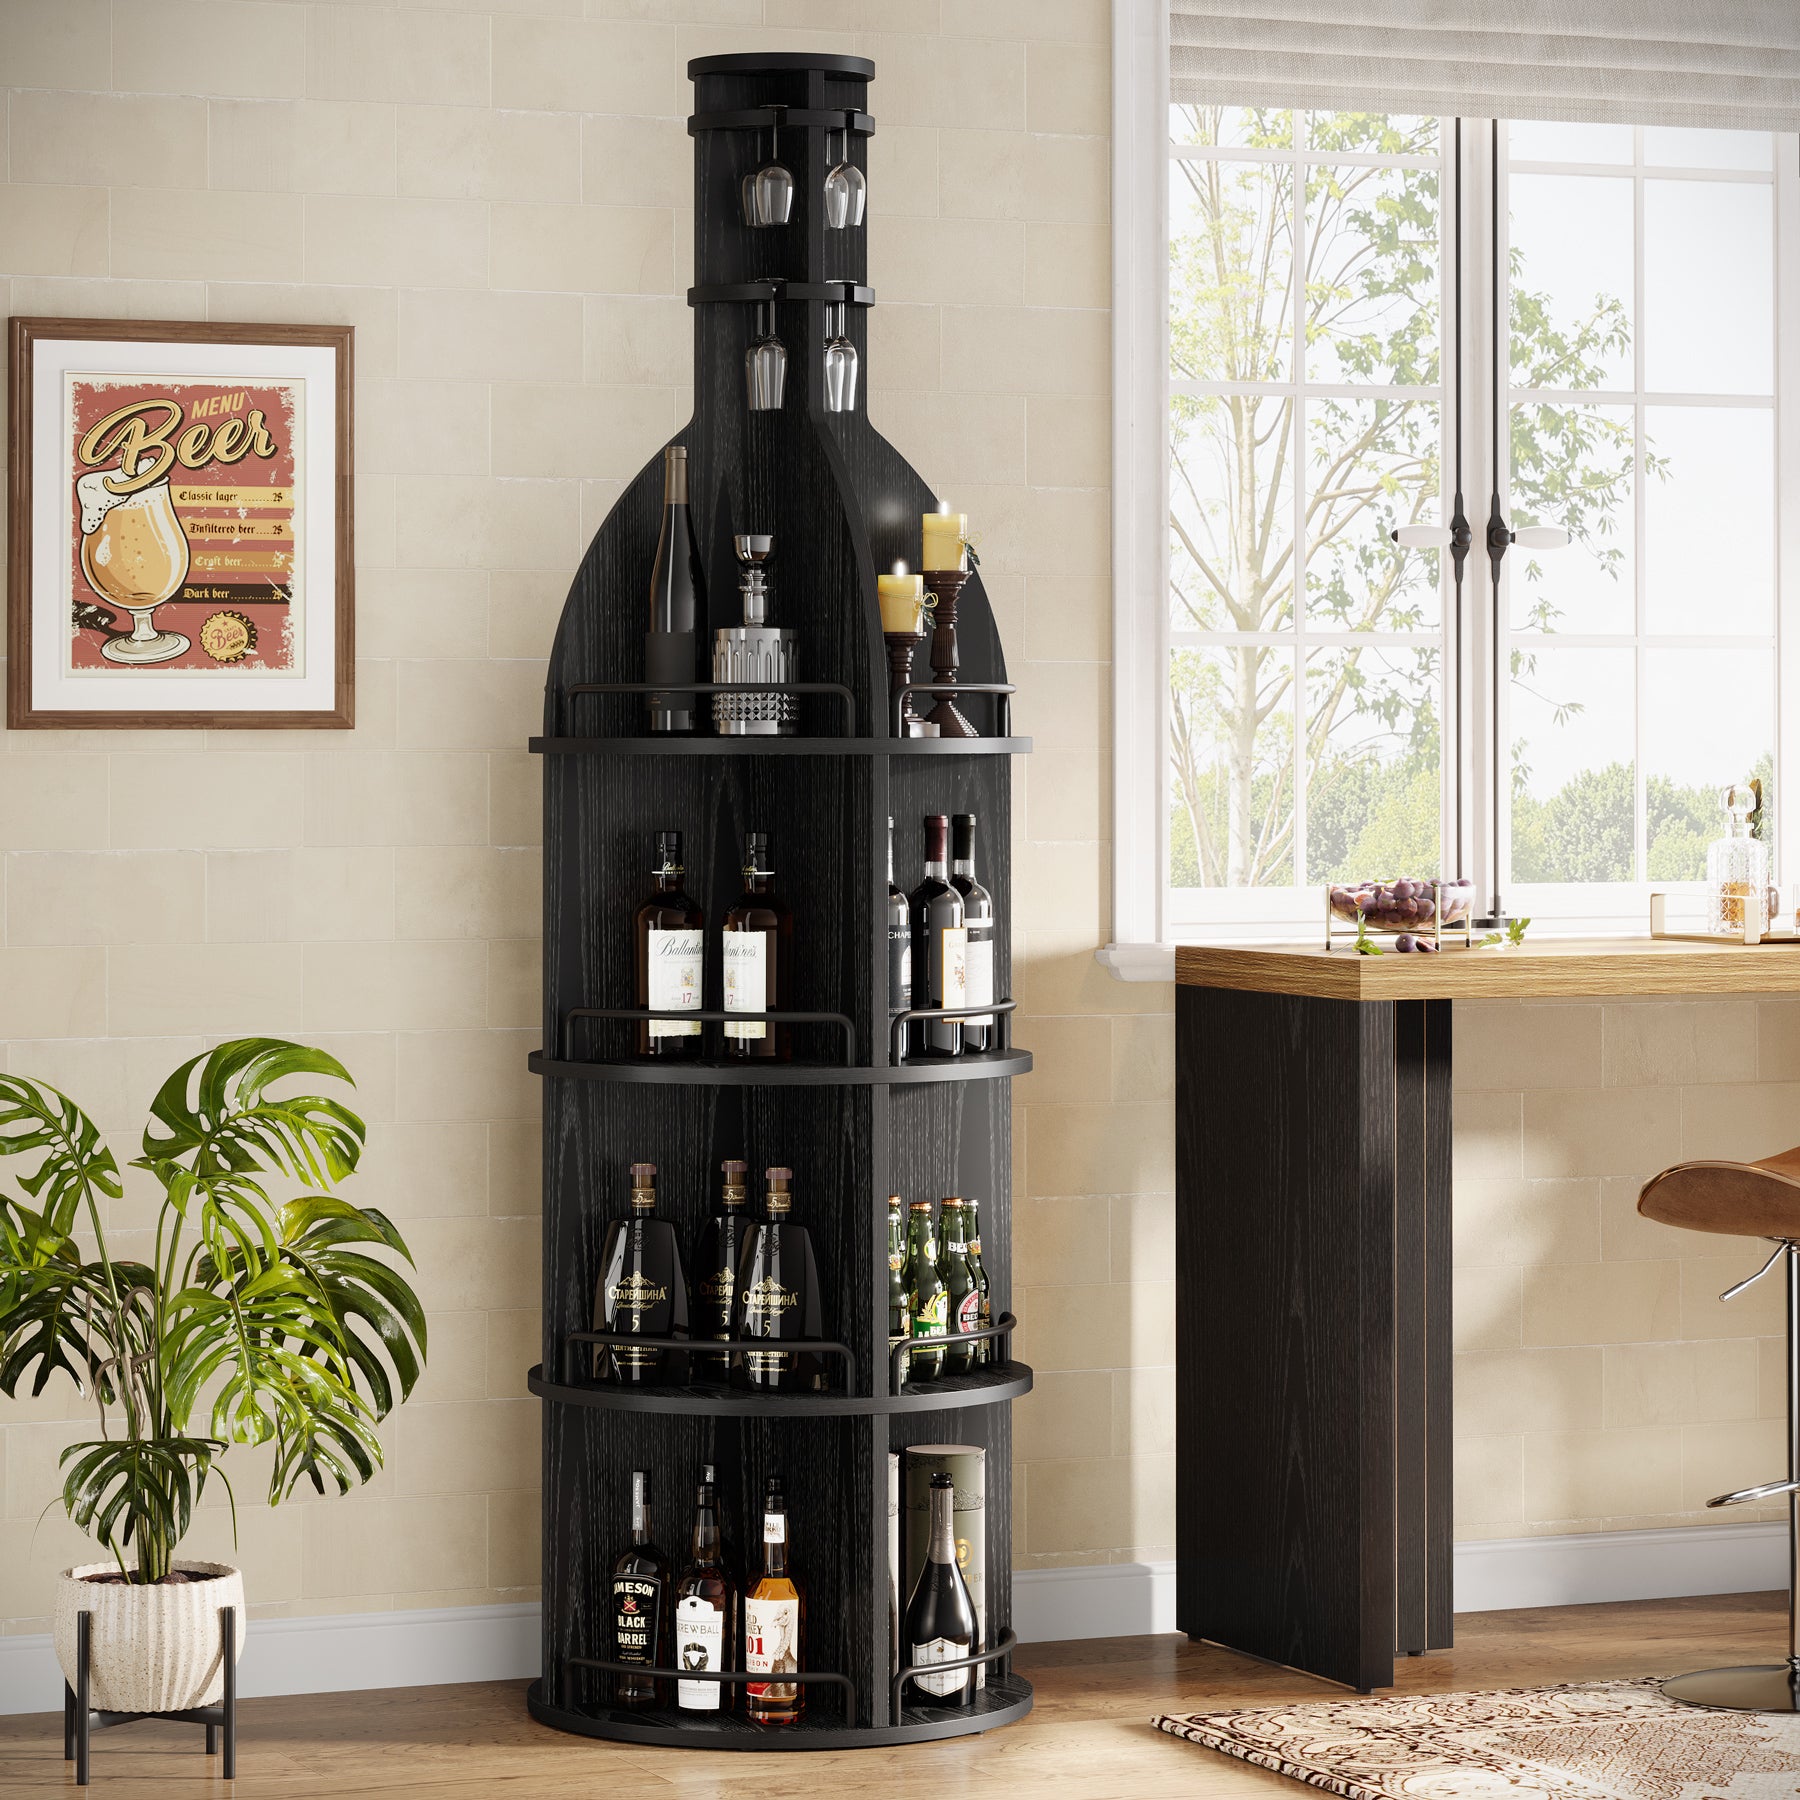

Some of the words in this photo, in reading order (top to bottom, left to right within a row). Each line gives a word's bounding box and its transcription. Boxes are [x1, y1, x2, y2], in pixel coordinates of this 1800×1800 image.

[191, 391, 245, 420] MENU
[78, 398, 278, 496] Beer
[179, 491, 213, 502] Classic
[216, 491, 238, 503] lager
[189, 522, 235, 534] Unfiltered
[238, 522, 255, 534] beer
[194, 556, 221, 568] Craft
[224, 556, 242, 567] beer
[183, 588, 209, 599] Dark
[212, 588, 230, 599] beer
[209, 627, 244, 651] Beer
[681, 992, 692, 1004] 17
[608, 1285, 667, 1301] СТАРЕЙШИНА
[742, 1290, 798, 1306] СТАРЕЙШИНА
[631, 1314, 640, 1332] 5
[721, 1310, 729, 1327] 5
[763, 1320, 771, 1337] 5
[617, 1614, 646, 1629] BLACK
[617, 1631, 648, 1646] BARREL
